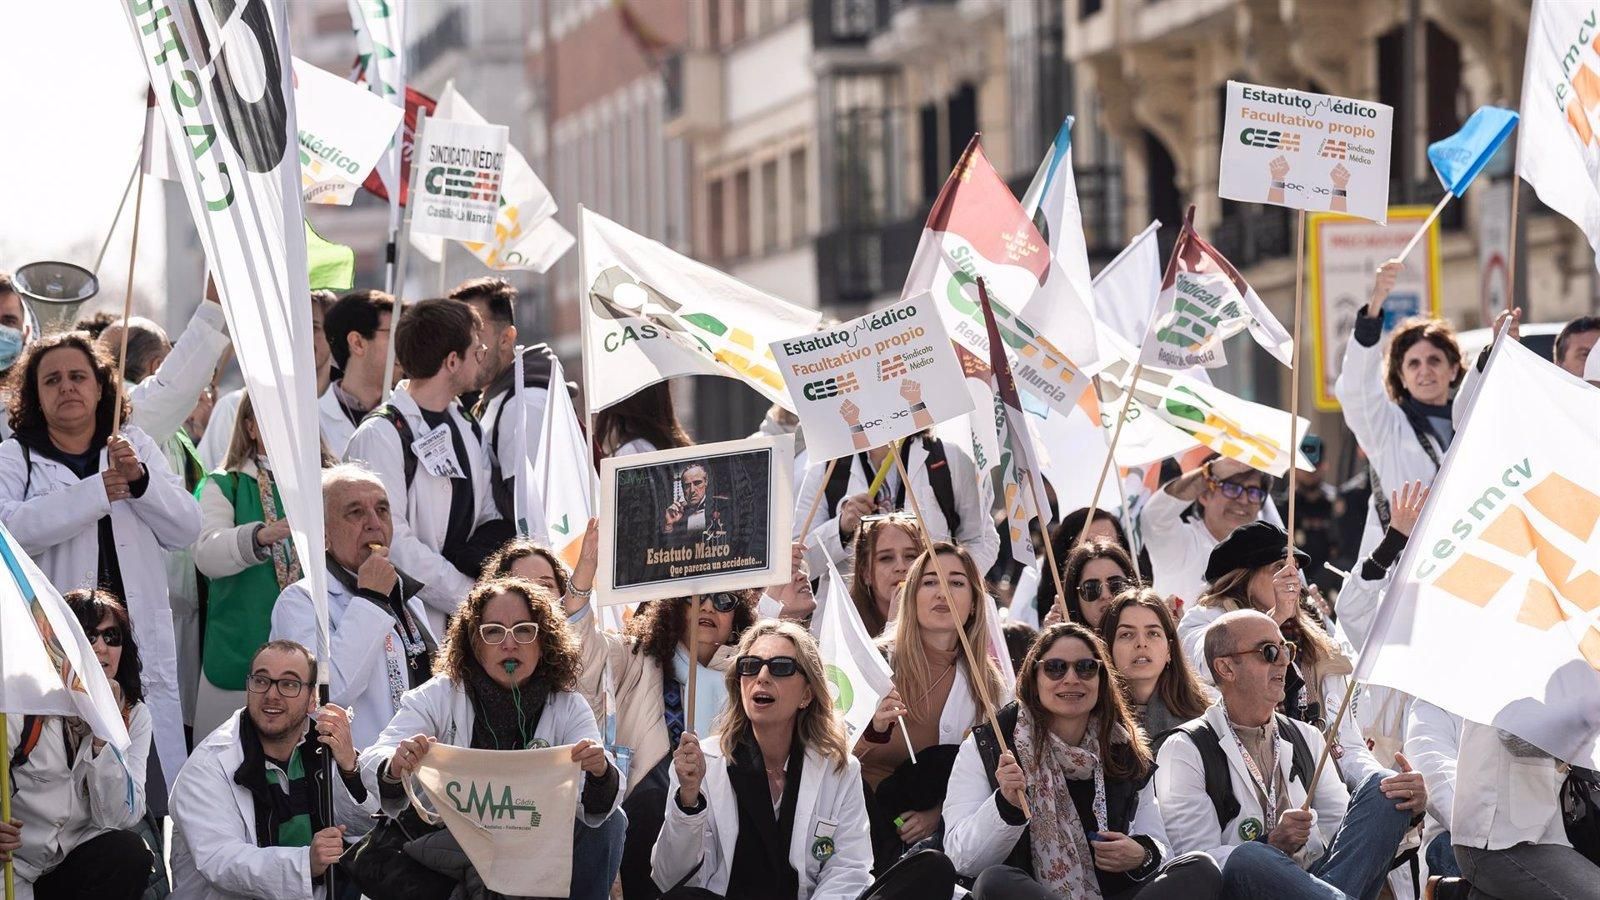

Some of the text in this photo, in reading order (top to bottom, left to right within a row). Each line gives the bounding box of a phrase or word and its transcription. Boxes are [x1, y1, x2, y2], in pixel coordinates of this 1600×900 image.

[1556, 9, 1597, 112] cemcv
[1242, 87, 1377, 118] Estatuto Médico
[1241, 107, 1376, 139] Facultativo propio
[430, 144, 471, 167] SINDICATO
[1347, 143, 1376, 156] Sindicato
[1349, 154, 1372, 165] Médico
[603, 324, 659, 353] CAS
[783, 305, 917, 357] Estatuto Médico
[791, 325, 925, 377] Facultativo propio
[902, 345, 934, 362] Sindicato
[909, 356, 935, 371] Médico
[954, 320, 990, 352] Regi
[1017, 364, 1067, 403] Murcia
[1415, 457, 1533, 580] cesmcv
[646, 542, 730, 564] Estatuto Marco
[669, 564, 684, 577] Que
[683, 563, 712, 577] parezca
[712, 561, 722, 569] un
[446, 781, 514, 820] SMA
